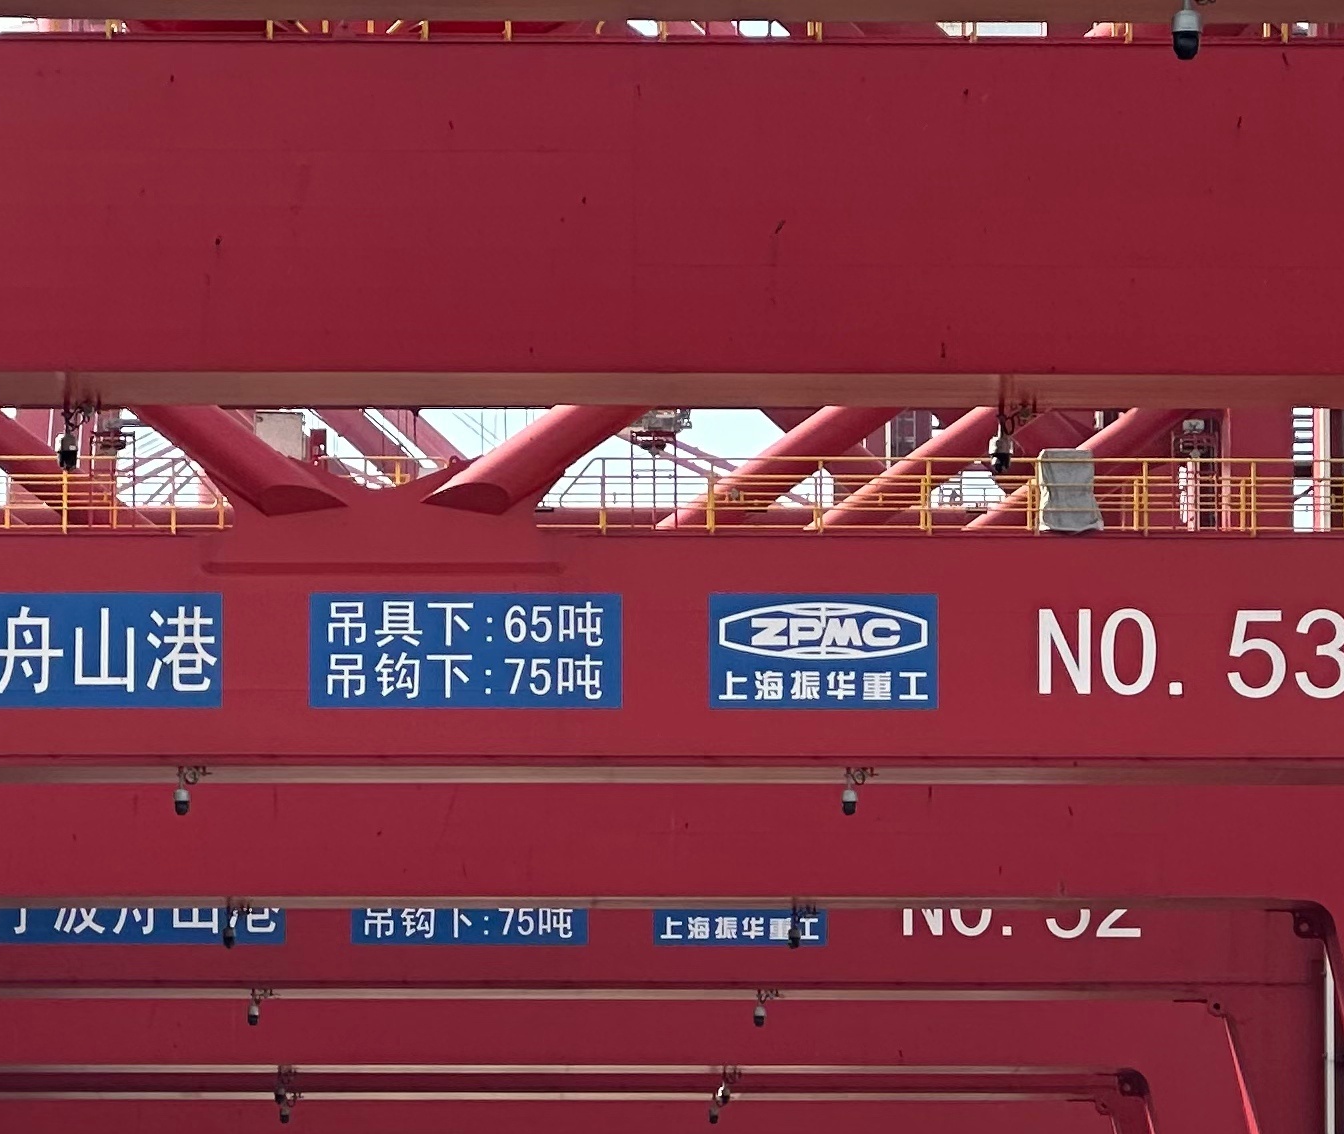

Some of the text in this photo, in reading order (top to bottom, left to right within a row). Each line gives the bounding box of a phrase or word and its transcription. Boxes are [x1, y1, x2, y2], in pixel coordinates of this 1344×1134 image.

[326, 601, 603, 647] 吊具下:65吨
[749, 615, 902, 650] ZPMC
[1039, 609, 1182, 695] NO.
[327, 652, 602, 699] 吊钩下:75吨
[719, 670, 928, 701] 上海振华重工
